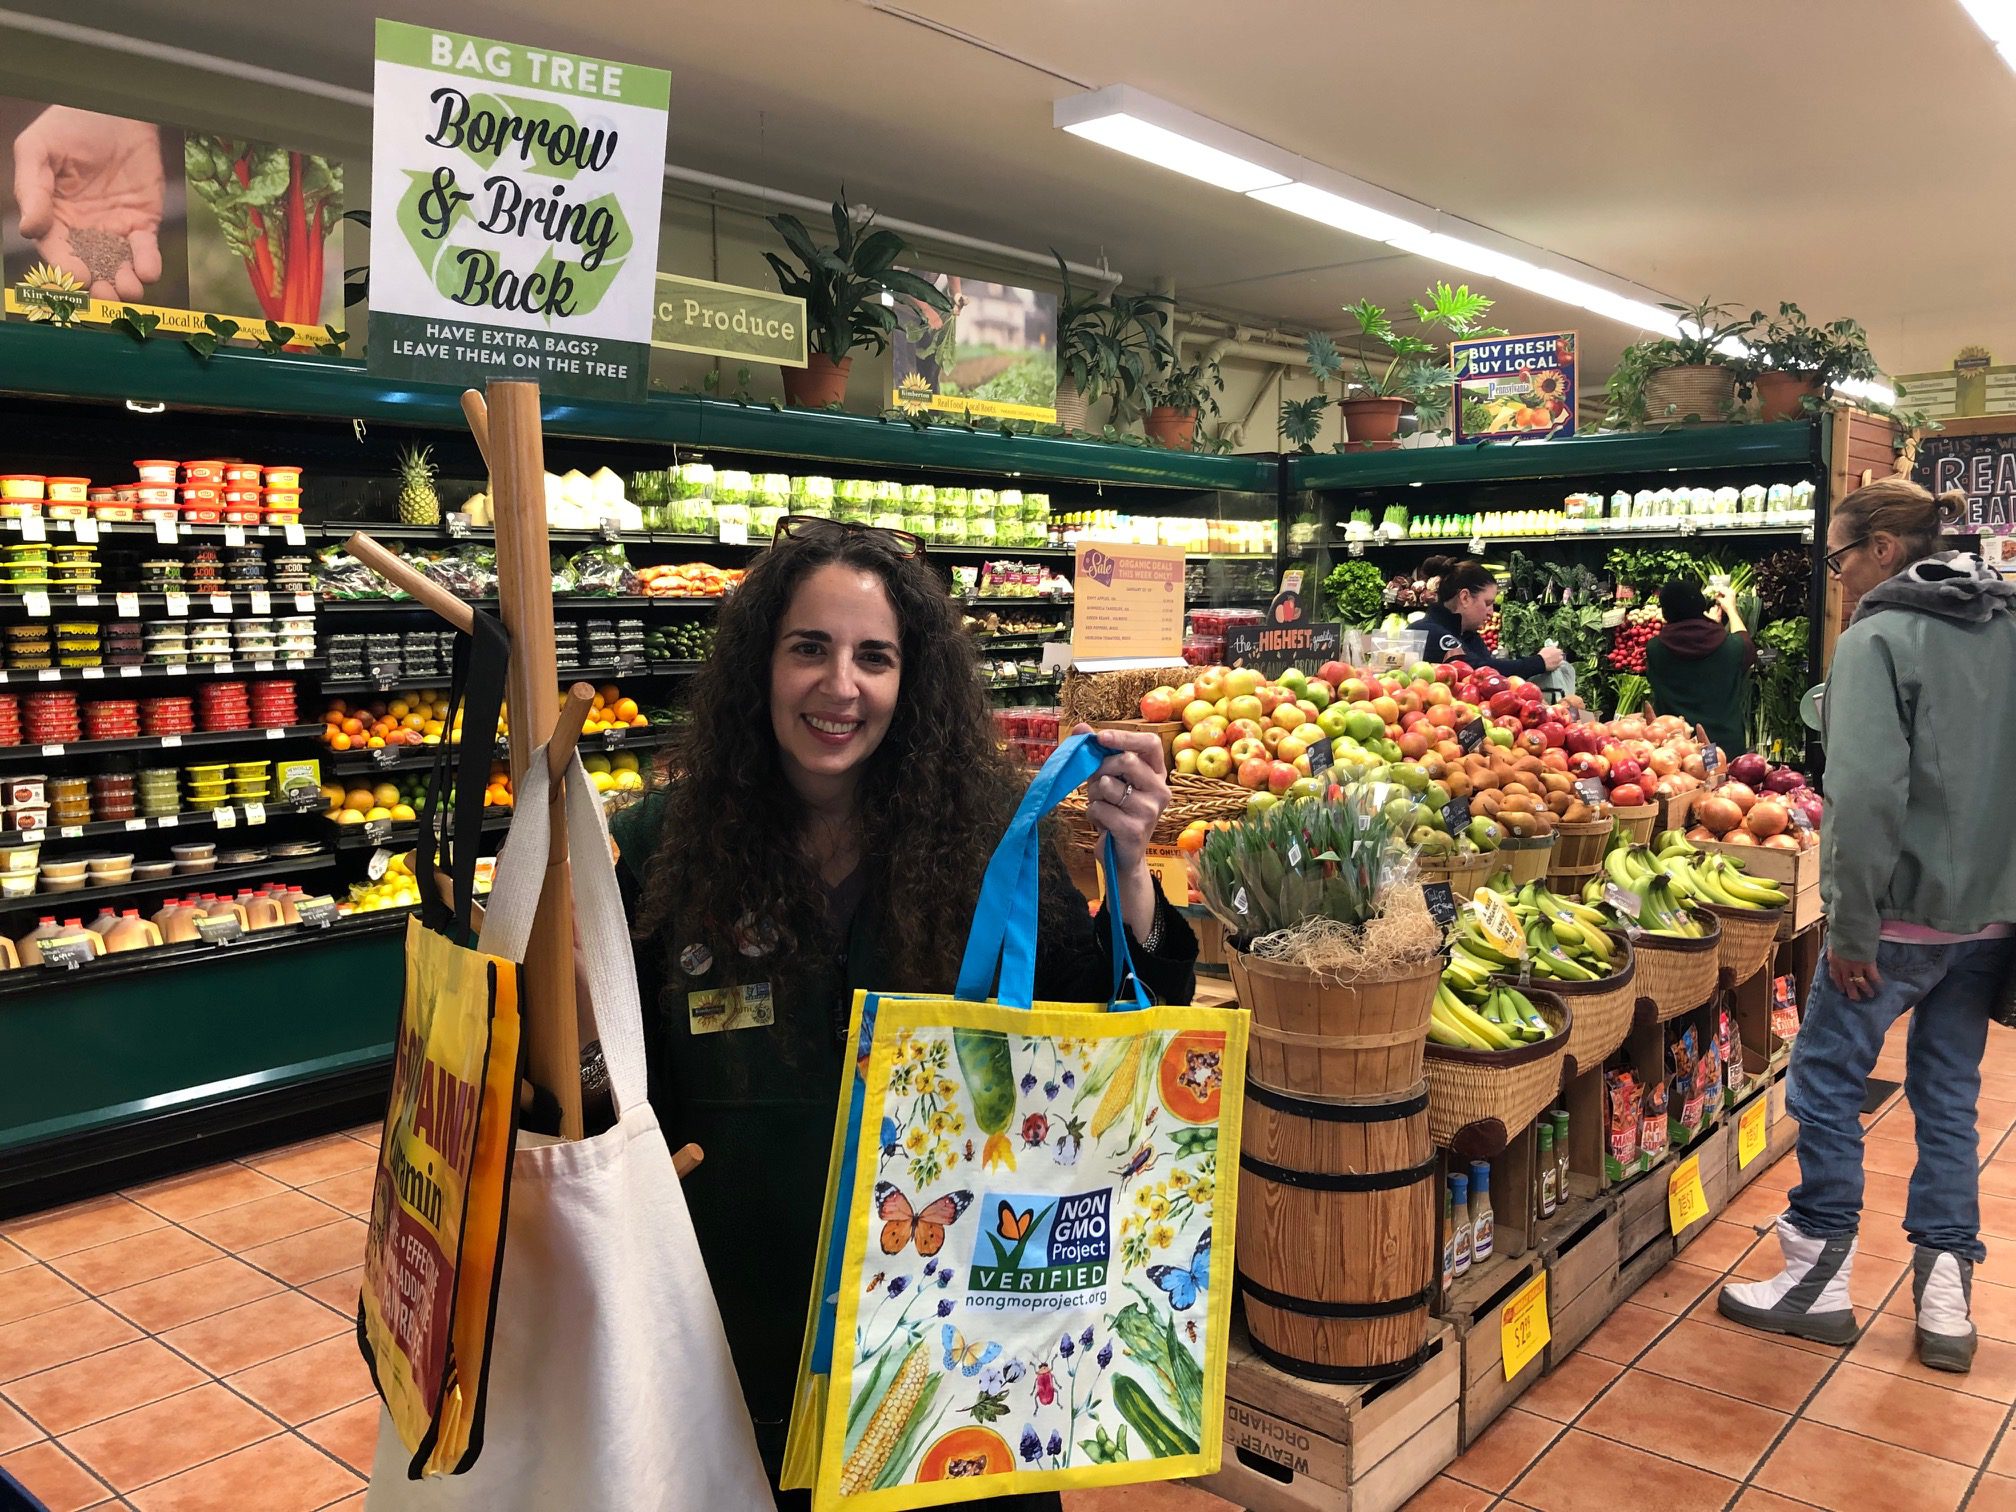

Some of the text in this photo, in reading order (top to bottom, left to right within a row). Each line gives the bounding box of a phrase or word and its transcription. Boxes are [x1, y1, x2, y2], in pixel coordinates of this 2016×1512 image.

[431, 33, 624, 97] BAG TREE
[425, 87, 618, 172] Borrow
[418, 166, 619, 272] & Bring
[451, 248, 578, 318] Back
[162, 312, 190, 327] Local
[684, 298, 795, 341] Produce
[426, 323, 599, 357] HAVE EXTRA BAGS?
[1469, 339, 1557, 359] BUY FRESH
[393, 340, 628, 380] LEAVE THEM ON THE TREE
[1469, 359, 1502, 375] BUY
[1082, 552, 1112, 578] Sale
[1060, 1194, 1106, 1220] NON
[1055, 1217, 1106, 1242] GMO
[1052, 1240, 1106, 1263] Project
[979, 1266, 1104, 1290] VERIFIED
[965, 1290, 1107, 1312] nongmoproject.org
[1228, 1406, 1309, 1451] ORCHARD
[1227, 1427, 1309, 1474] WEAVER'S
